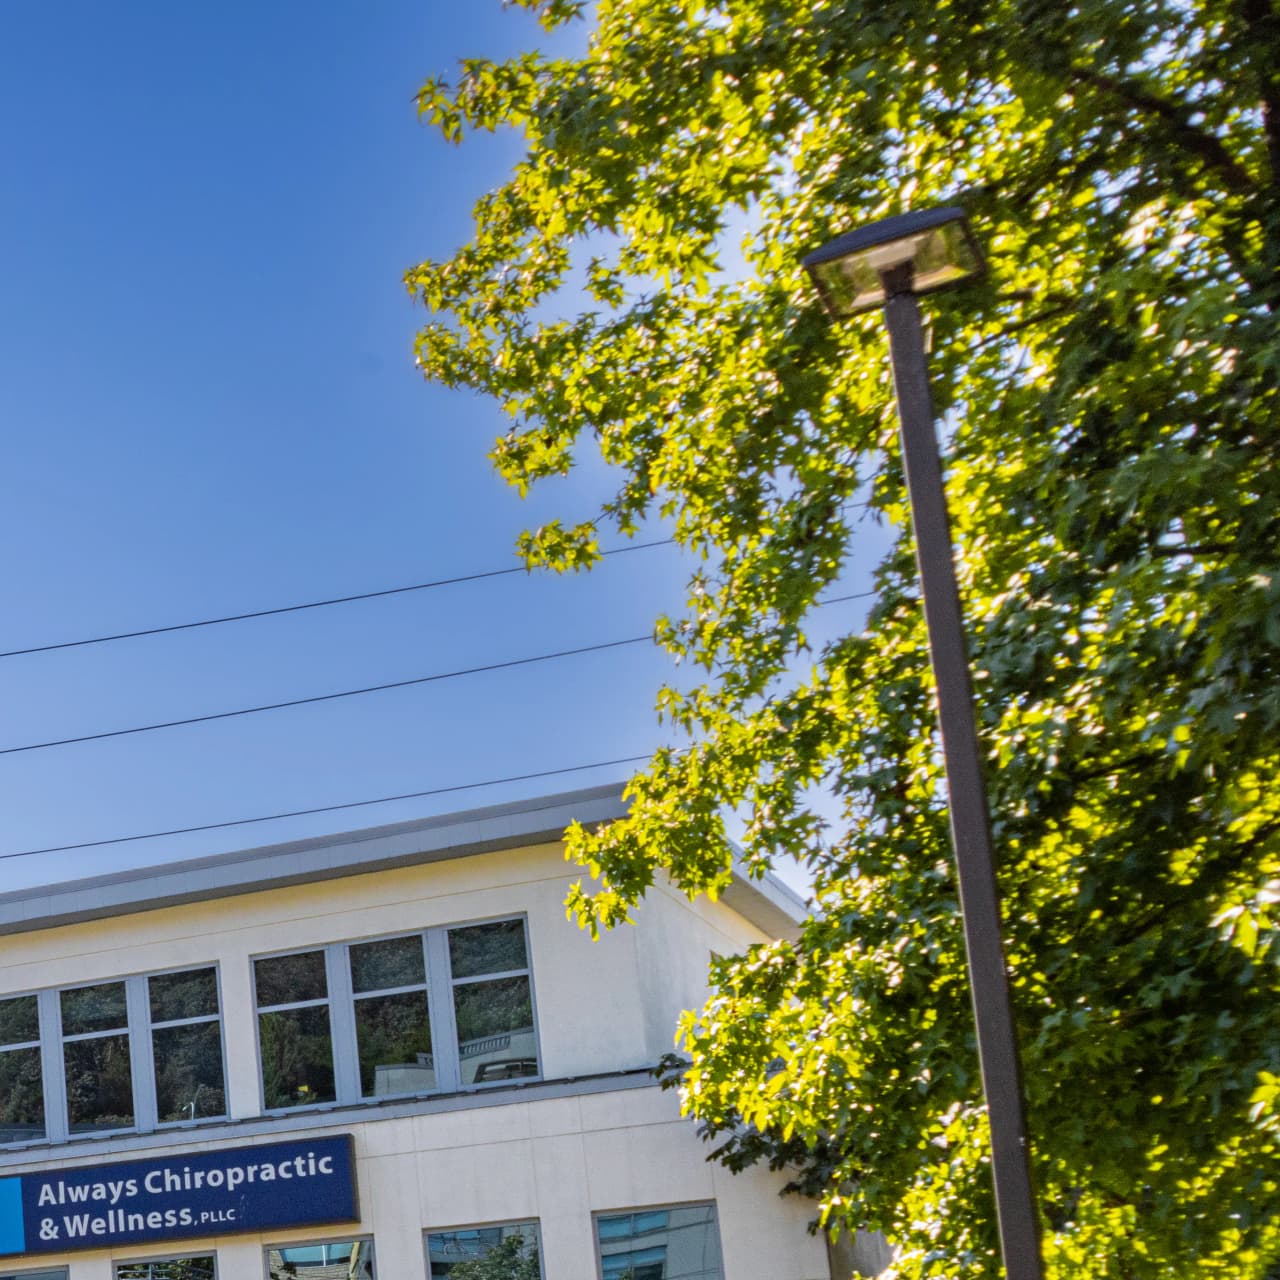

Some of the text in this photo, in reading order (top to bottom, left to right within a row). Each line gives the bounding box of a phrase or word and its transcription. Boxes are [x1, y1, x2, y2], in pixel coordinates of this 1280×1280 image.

[38, 1151, 334, 1207] Always Chiropractic
[38, 1208, 236, 1241] & Wellness, PLLC
